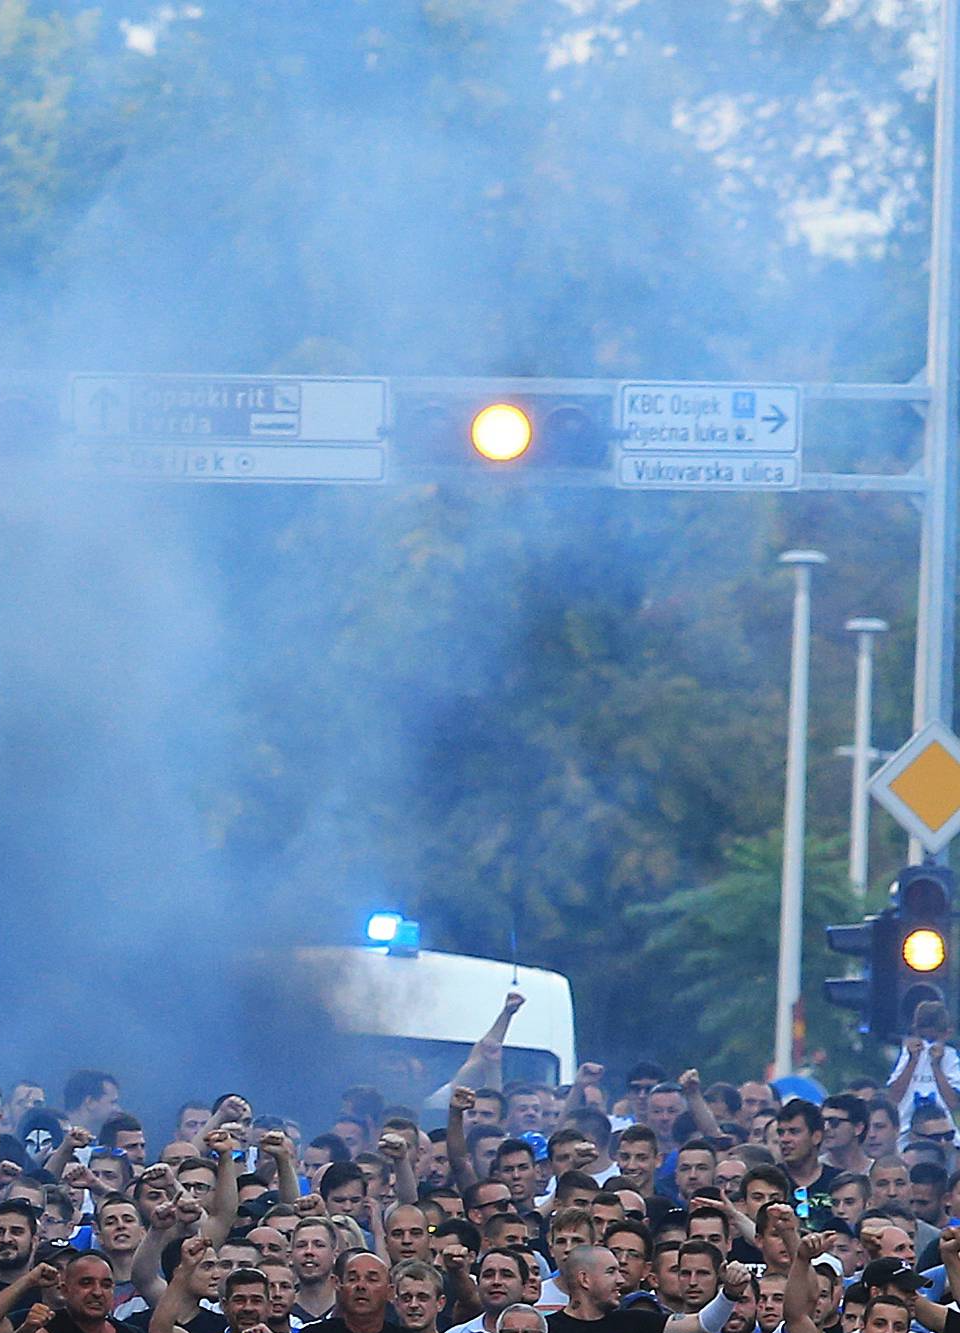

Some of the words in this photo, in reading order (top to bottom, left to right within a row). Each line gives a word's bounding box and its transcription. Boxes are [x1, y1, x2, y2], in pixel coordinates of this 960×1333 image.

[235, 387, 266, 407] rit
[628, 393, 664, 414] KBC
[694, 422, 728, 442] luka
[634, 460, 734, 481] Vukovarska
[742, 462, 784, 482] ulica
